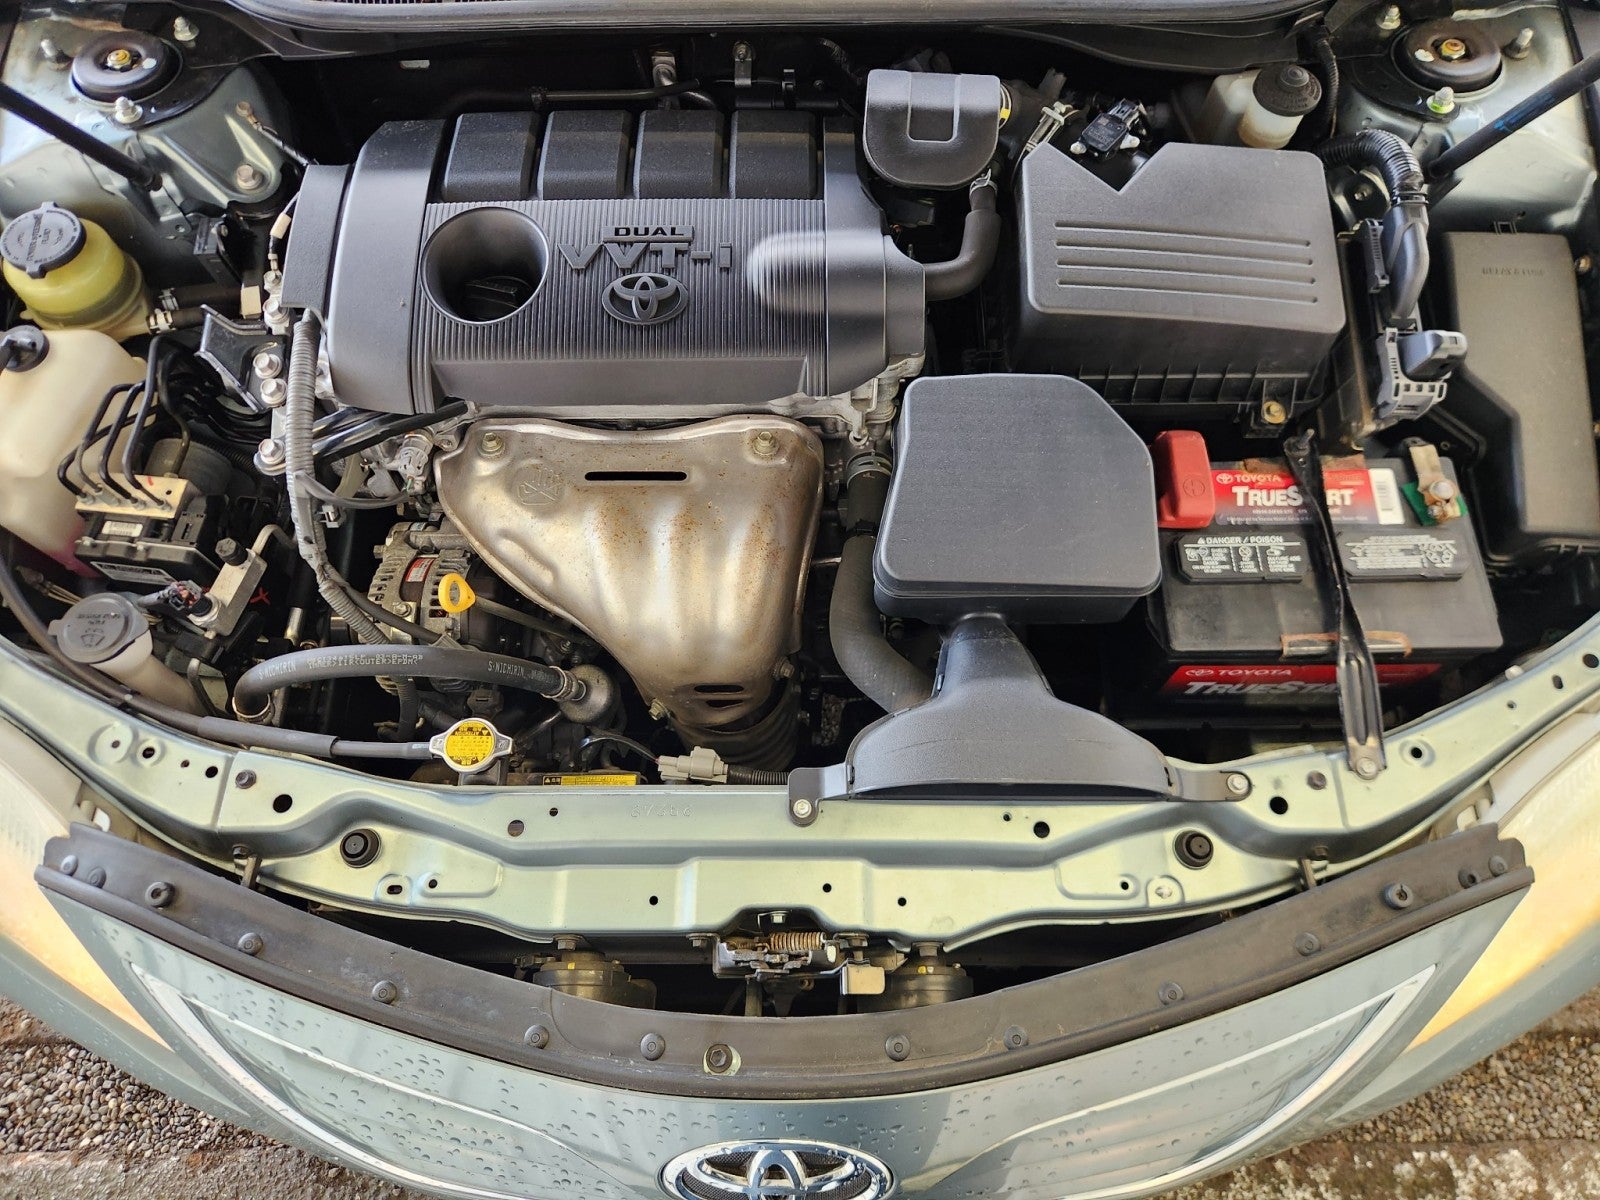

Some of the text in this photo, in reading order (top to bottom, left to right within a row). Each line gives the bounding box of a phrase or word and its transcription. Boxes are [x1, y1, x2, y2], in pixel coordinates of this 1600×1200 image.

[614, 226, 684, 237] DUAL
[1234, 474, 1281, 483] TOYOTA
[1232, 485, 1354, 506] TRUESRT
[1206, 536, 1242, 544] DANGER
[1250, 535, 1284, 543] POISON
